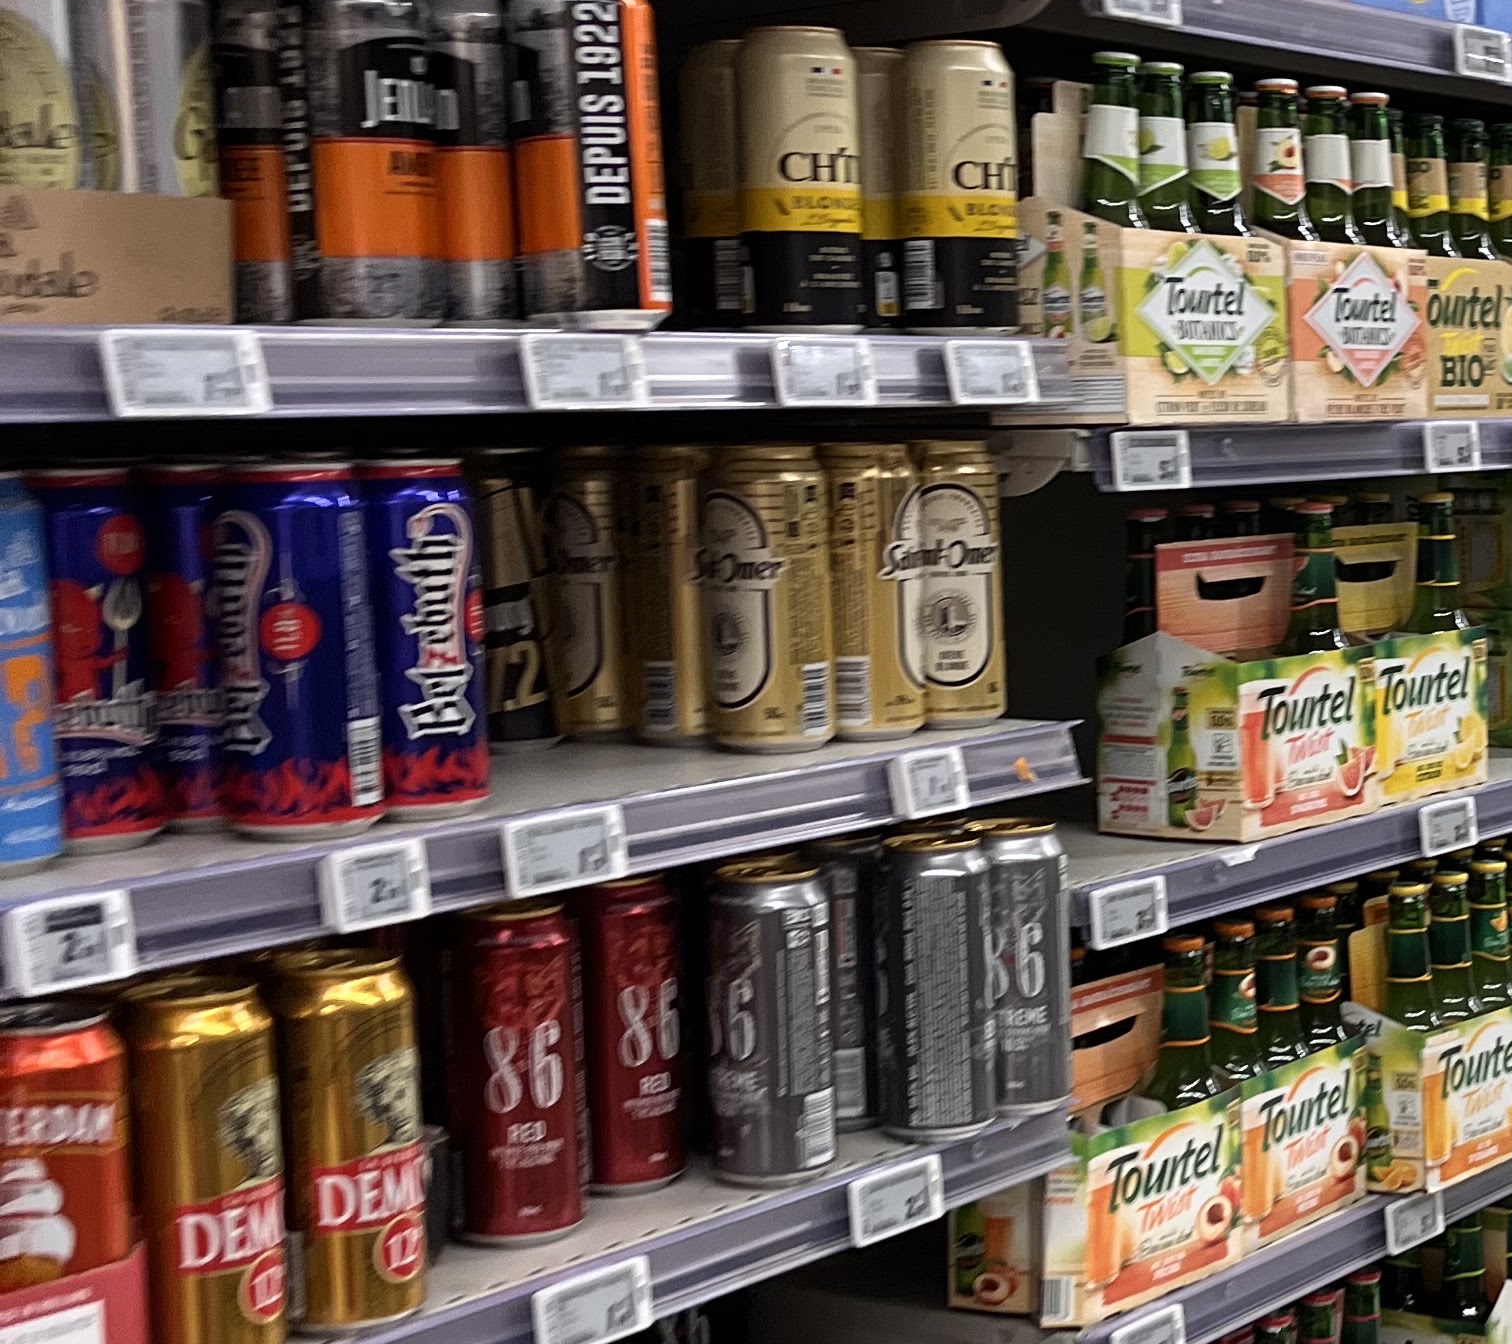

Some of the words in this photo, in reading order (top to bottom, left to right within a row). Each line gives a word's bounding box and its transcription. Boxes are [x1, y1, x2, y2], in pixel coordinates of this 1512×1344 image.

[571, 1, 625, 88] 1922
[579, 92, 631, 205] DEPUIS
[1164, 276, 1245, 316] Tourtel
[1333, 287, 1397, 323] Tourtel
[1440, 355, 1484, 388] BIO
[1257, 675, 1356, 741] Tourtel
[1378, 658, 1470, 717] Tourtel
[3, 1102, 115, 1147] ERDAM
[1259, 1070, 1352, 1154] Tourtel
[315, 1152, 428, 1228] DEM
[1108, 1123, 1225, 1215] Tourtel
[178, 1201, 285, 1270] DEM
[1137, 1185, 1199, 1231] Twist
